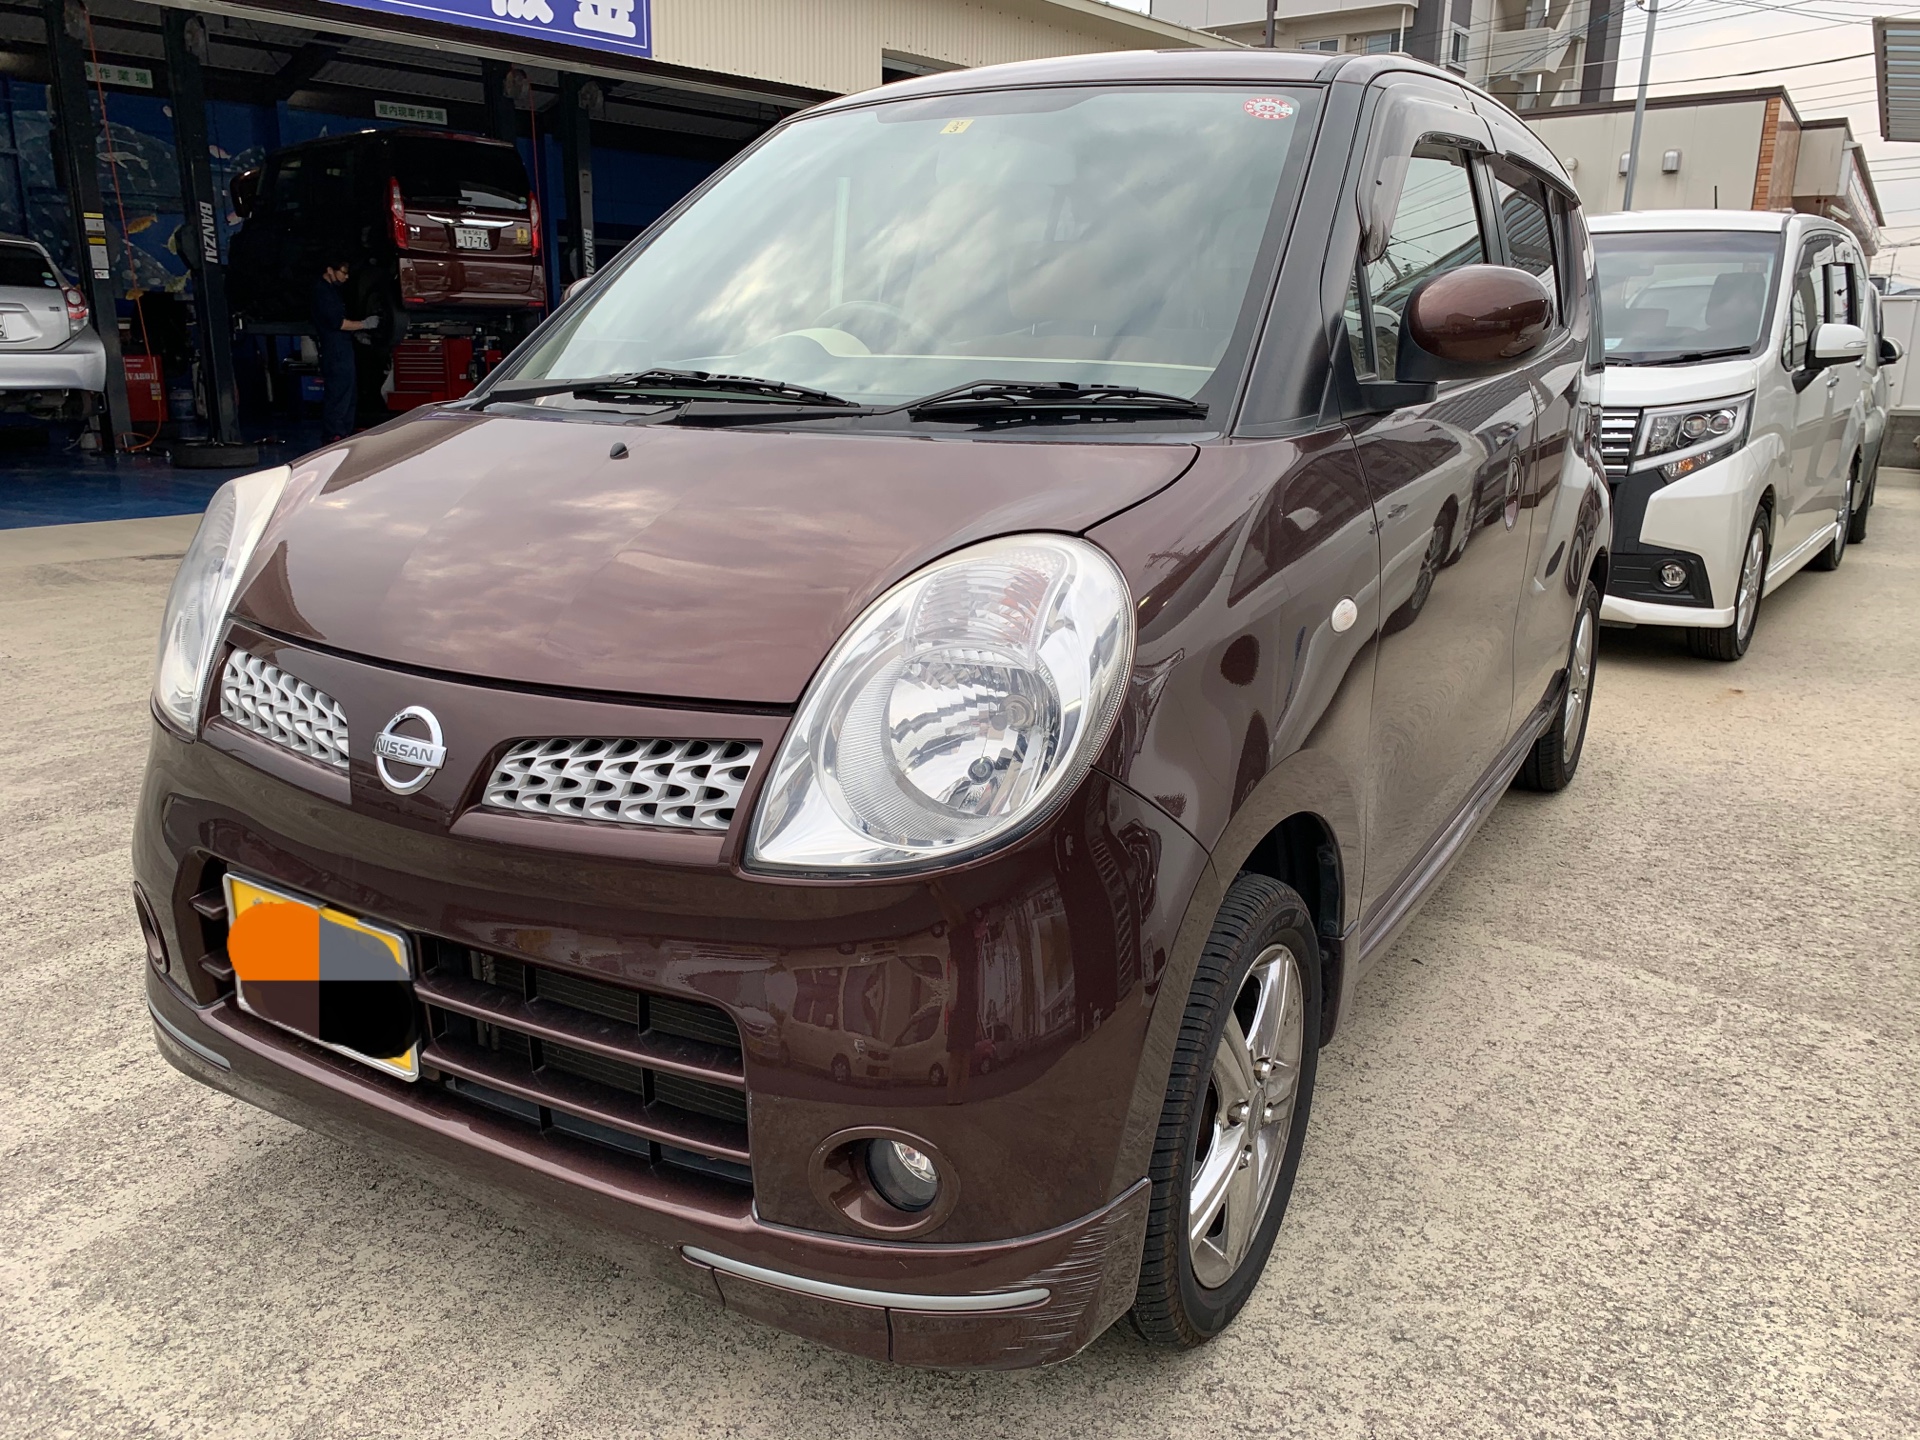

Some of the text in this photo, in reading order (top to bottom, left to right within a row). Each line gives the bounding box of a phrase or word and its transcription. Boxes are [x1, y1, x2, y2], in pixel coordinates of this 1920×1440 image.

[199, 200, 219, 264] BANZAI
[463, 235, 489, 248] 17-76
[376, 737, 434, 762] NISSAN
